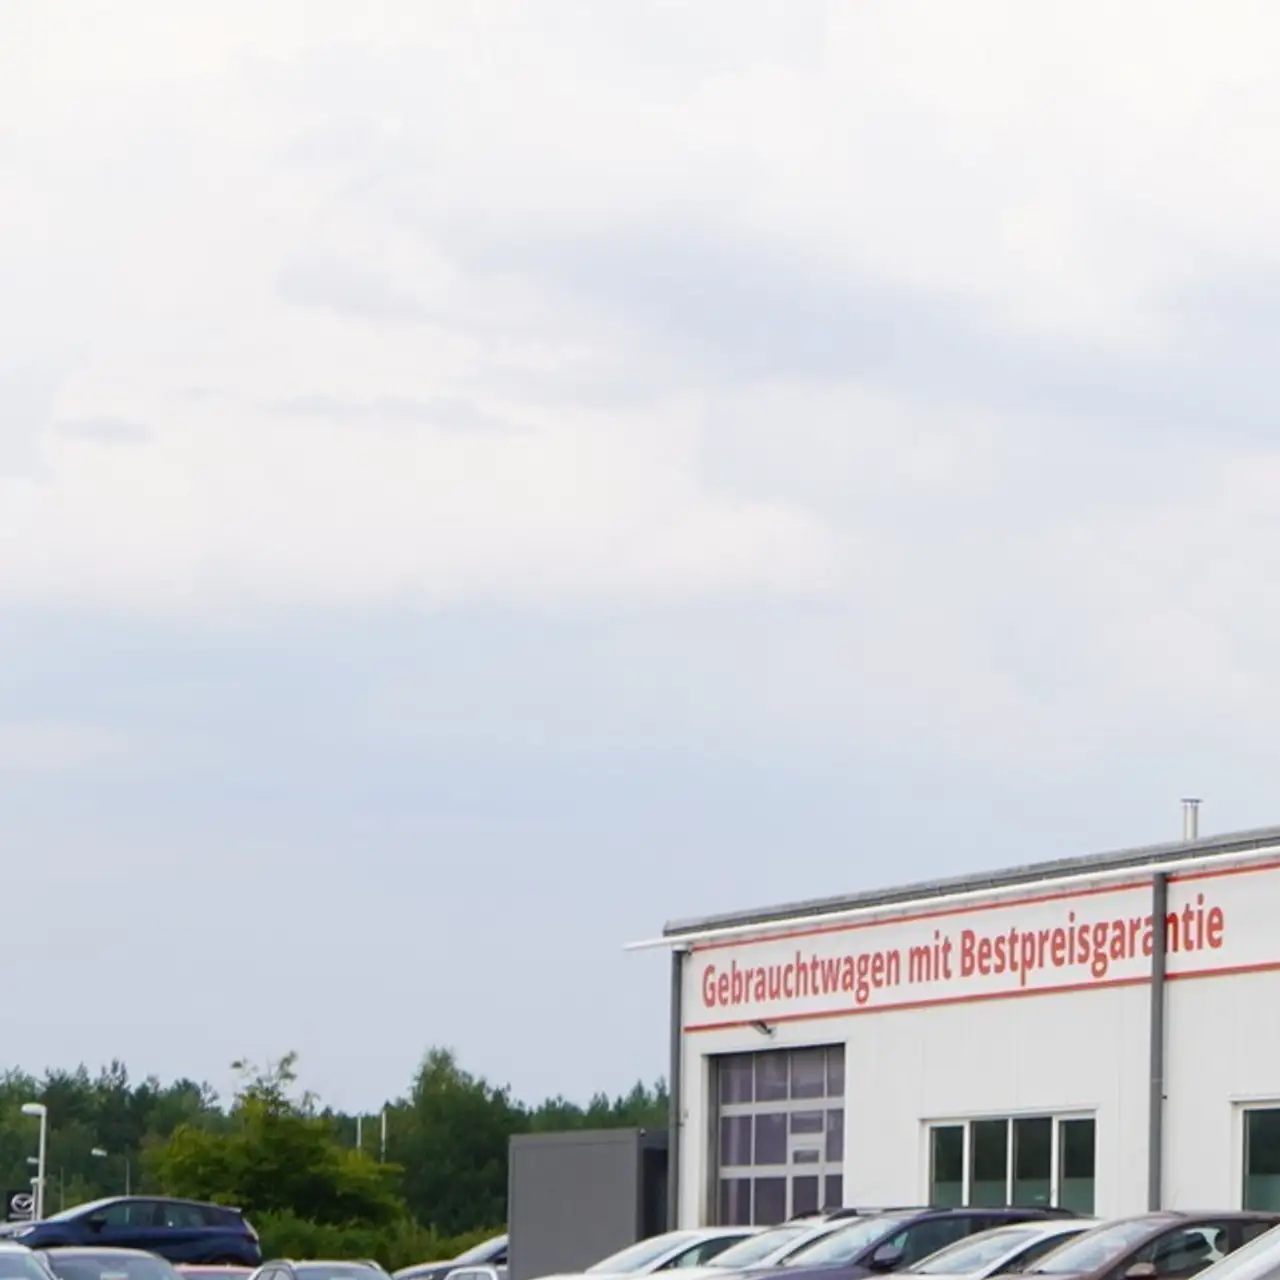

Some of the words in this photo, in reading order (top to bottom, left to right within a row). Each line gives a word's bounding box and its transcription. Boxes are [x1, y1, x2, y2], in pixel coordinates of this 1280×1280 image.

[702, 951, 901, 1009] Gebrauchtwagen
[907, 932, 953, 982] mit
[959, 893, 1225, 986] Bestpreisgarantie
